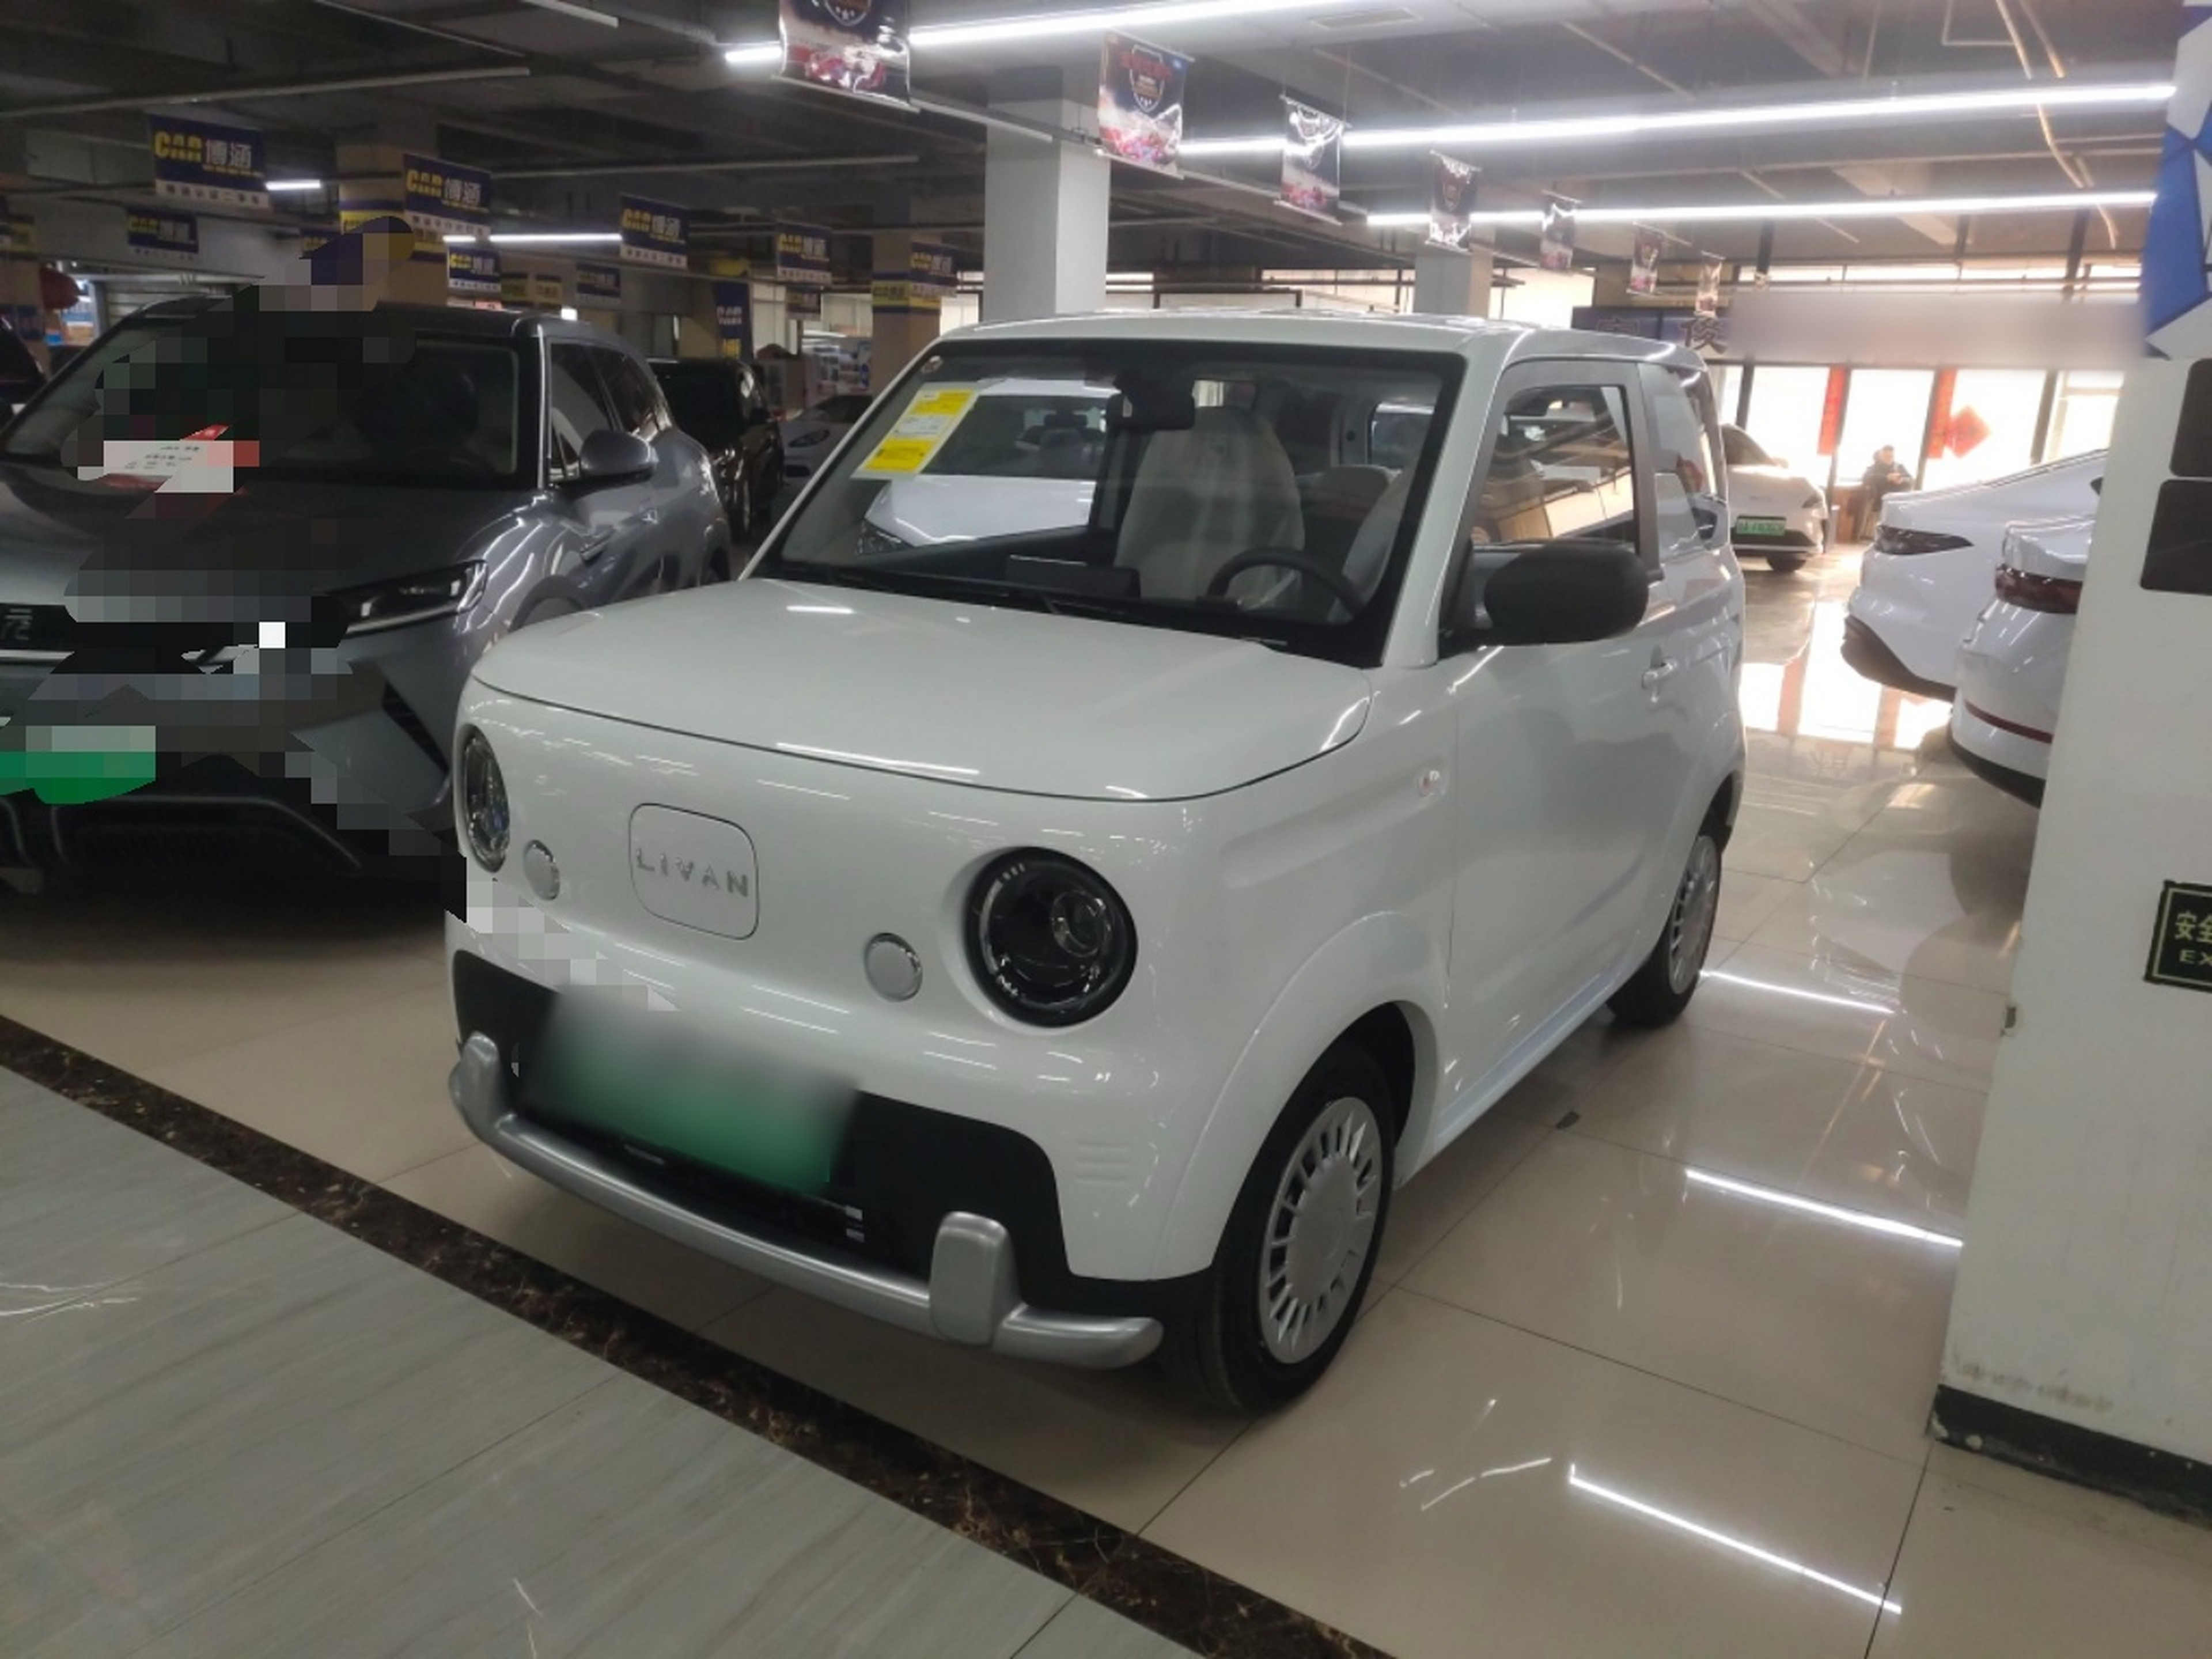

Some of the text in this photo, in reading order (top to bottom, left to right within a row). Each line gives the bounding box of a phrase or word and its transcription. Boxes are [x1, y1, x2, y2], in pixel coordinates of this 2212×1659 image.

[155, 131, 202, 162] CAR
[407, 169, 443, 197] CAR
[636, 848, 748, 897] LIVAN
